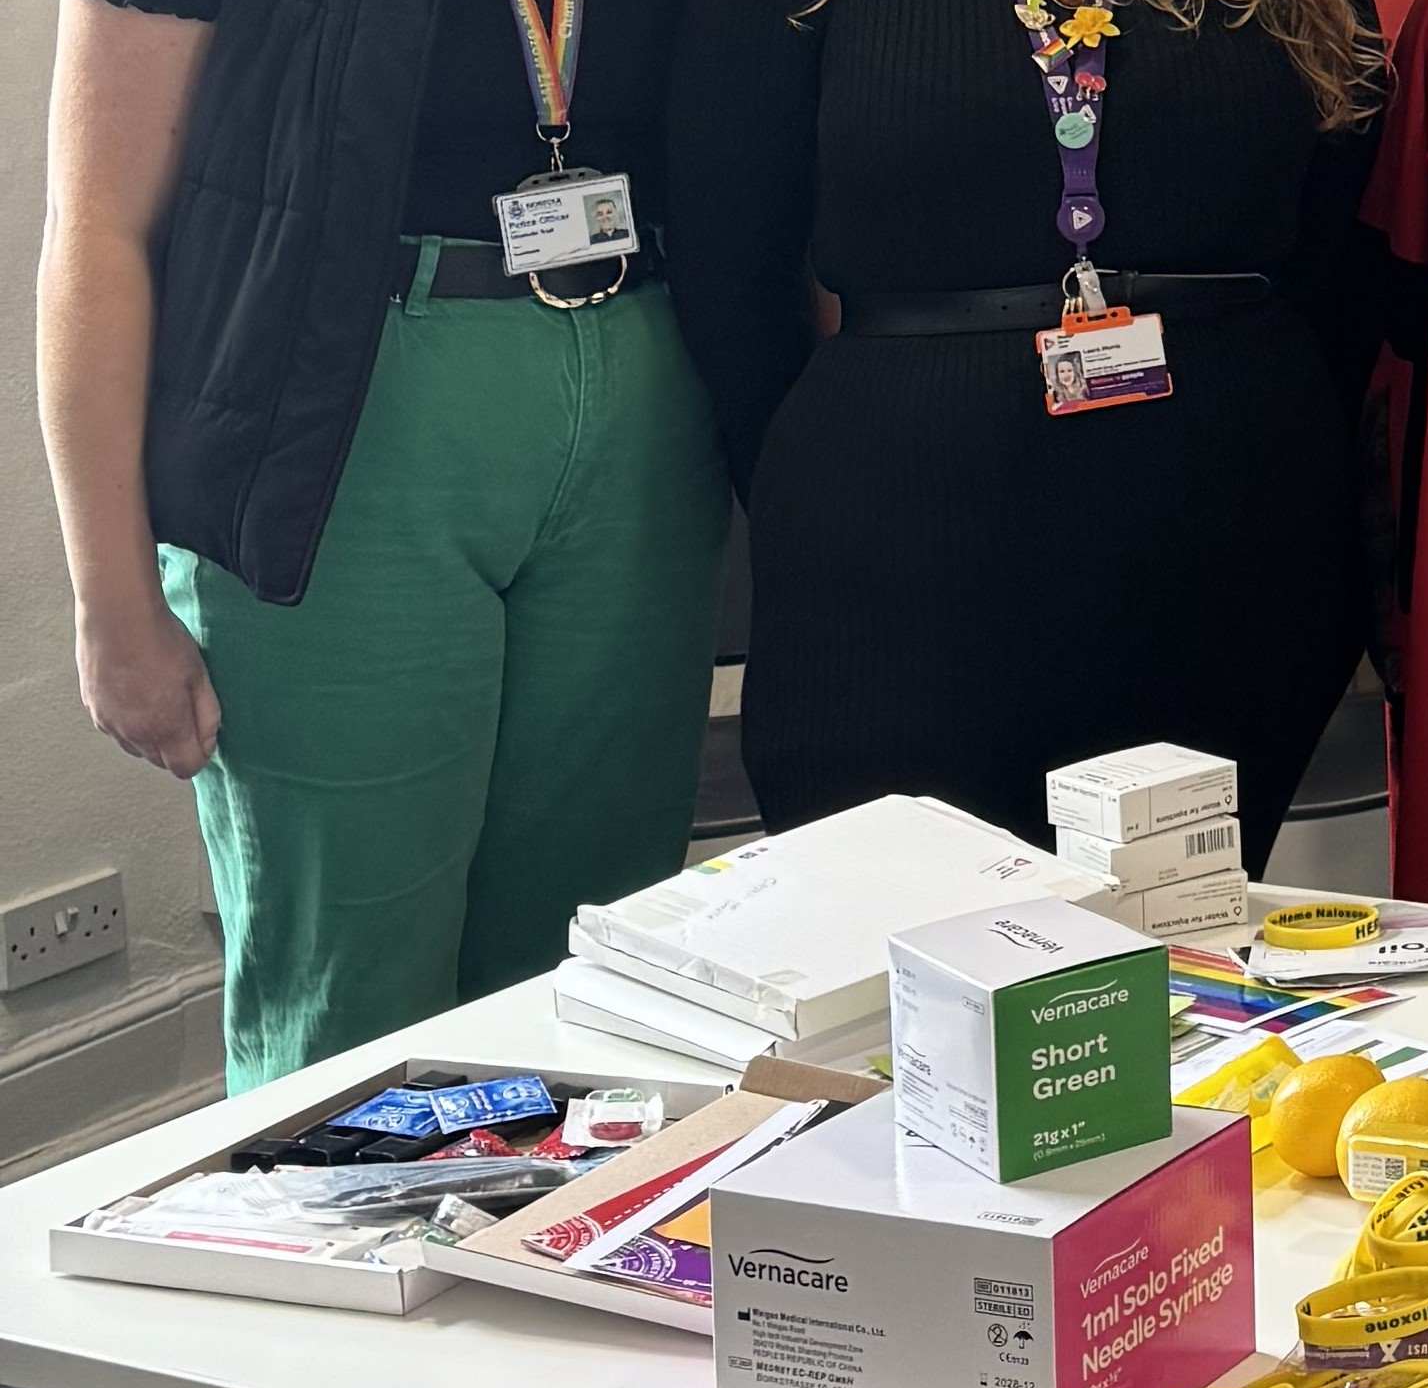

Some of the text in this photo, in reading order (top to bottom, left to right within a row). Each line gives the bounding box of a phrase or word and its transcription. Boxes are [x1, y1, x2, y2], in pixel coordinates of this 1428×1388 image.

[1031, 988, 1130, 1025] Vernacare
[1031, 1033, 1109, 1071] Short
[1032, 1063, 1117, 1101] Green
[1033, 1129, 1058, 1147] 21g
[1060, 1126, 1070, 1139] x
[728, 1253, 849, 1293] Vernacare
[1080, 1244, 1150, 1299] Vernacare
[1081, 1225, 1224, 1341] 1ml Solo Fixed
[977, 1300, 1012, 1314] STERILE
[1082, 1263, 1234, 1381] Needle Syringe
